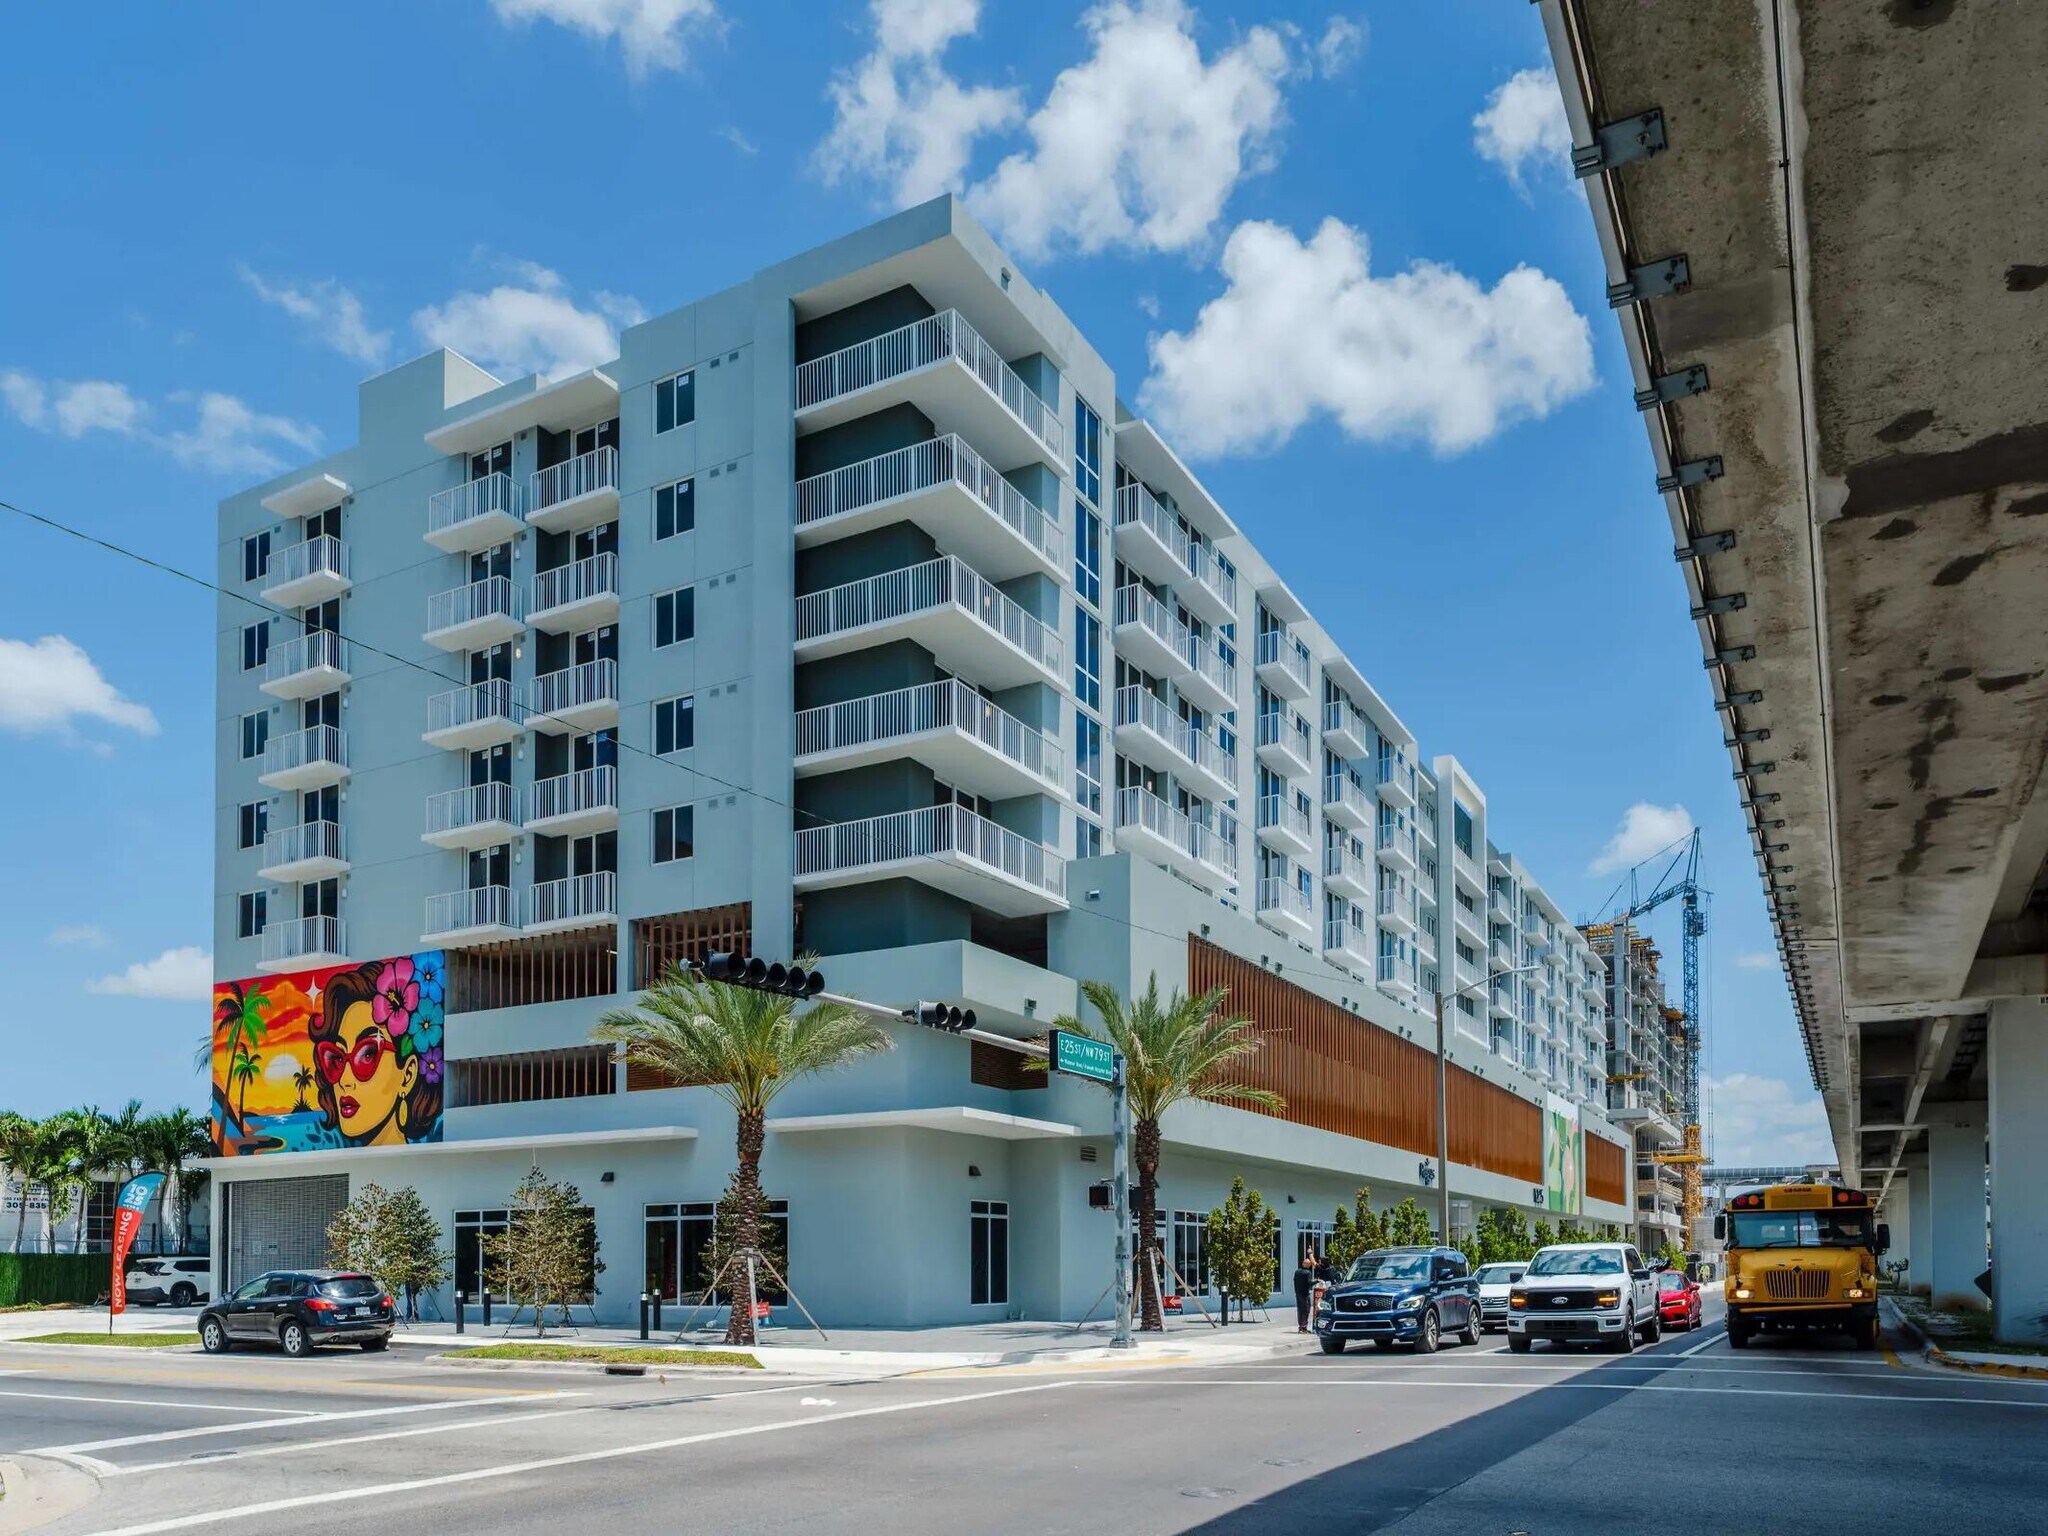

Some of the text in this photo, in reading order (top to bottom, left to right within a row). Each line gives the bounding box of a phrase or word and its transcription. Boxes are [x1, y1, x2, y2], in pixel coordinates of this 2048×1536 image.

[1065, 1040, 1074, 1054] 25
[1094, 1047, 1103, 1061] 79
[116, 1211, 133, 1269] LEASING
[115, 1274, 123, 1308] NOW
